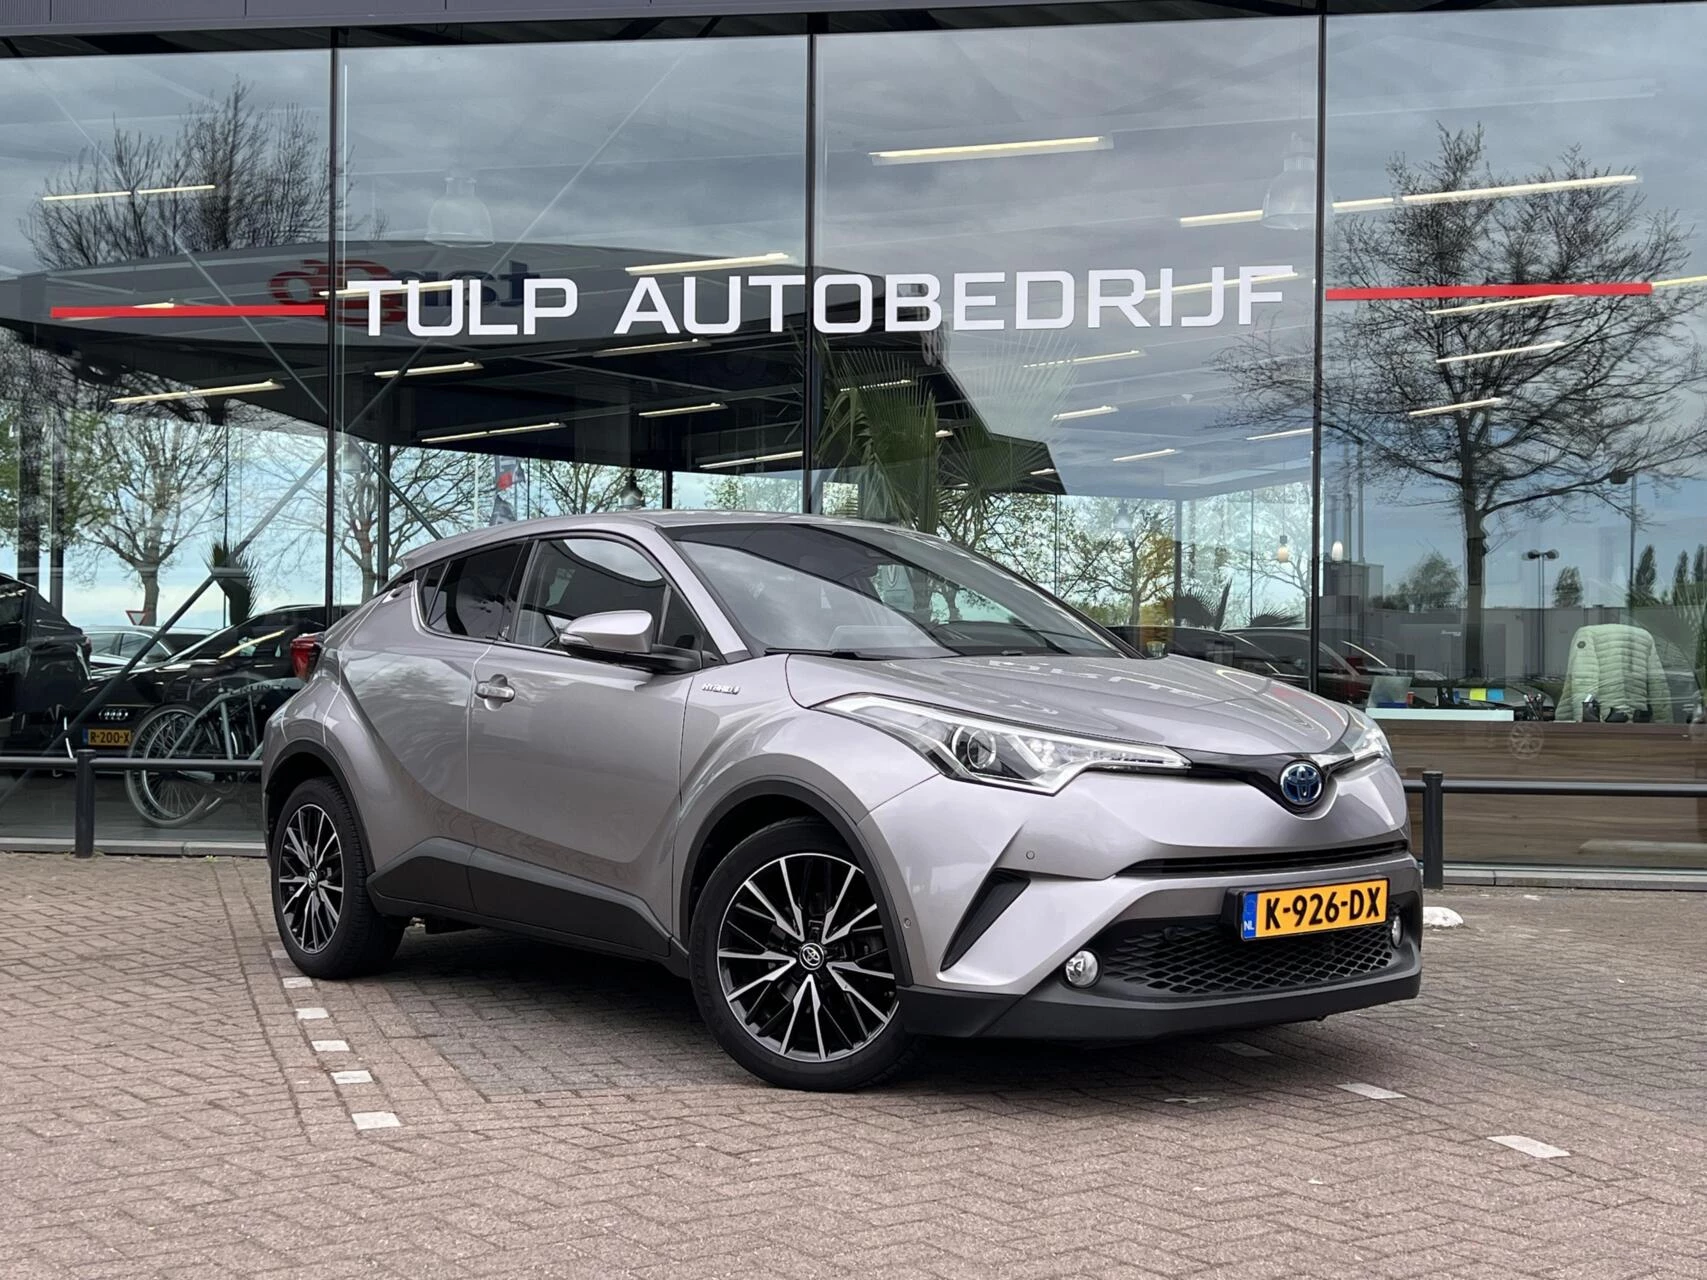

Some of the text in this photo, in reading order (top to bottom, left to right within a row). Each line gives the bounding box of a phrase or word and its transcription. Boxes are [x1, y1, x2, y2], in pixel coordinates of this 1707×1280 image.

[347, 265, 1292, 336] TULP AUTOBEDRIJF
[90, 731, 130, 744] R-200-X
[1243, 886, 1381, 931] NL K-926-DX
